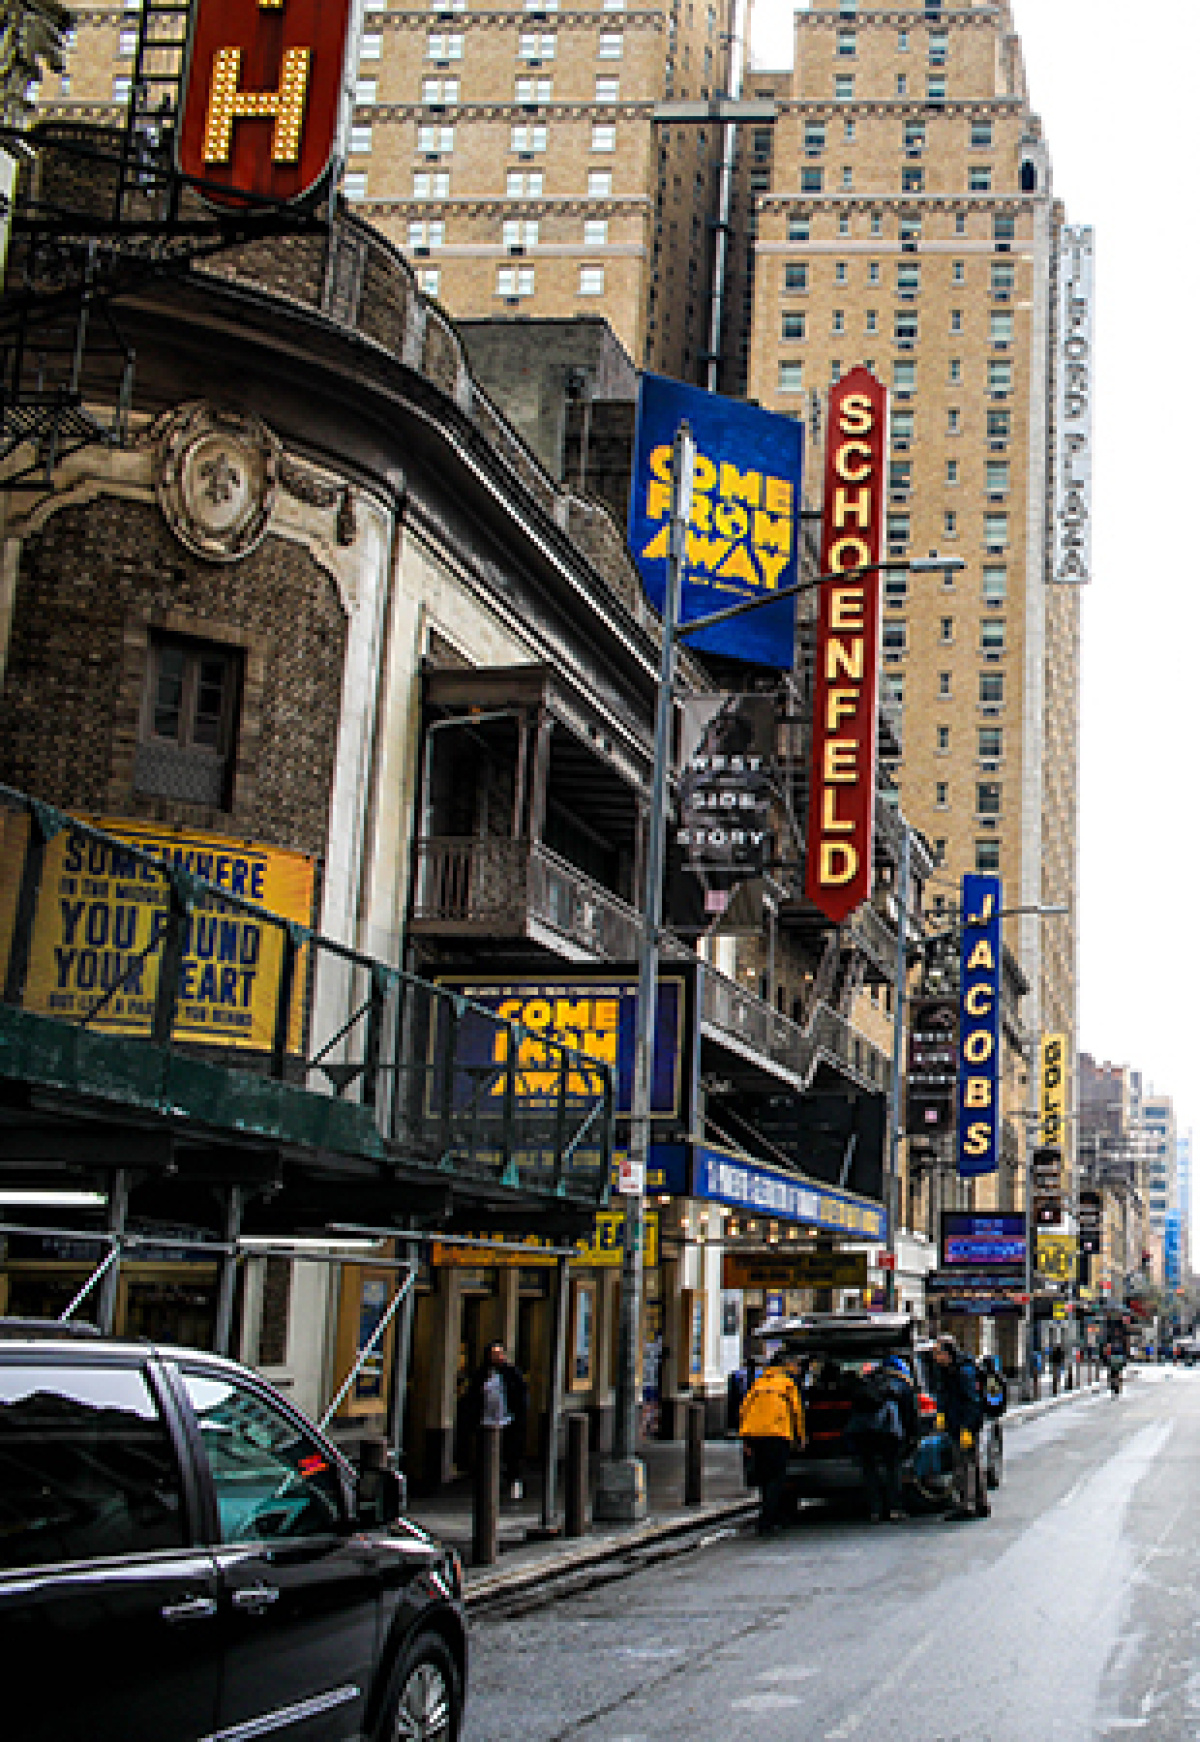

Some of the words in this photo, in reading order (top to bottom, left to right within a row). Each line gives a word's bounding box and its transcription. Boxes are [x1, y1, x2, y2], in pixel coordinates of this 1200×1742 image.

[202, 0, 311, 164] H
[648, 444, 794, 511] COME
[1058, 432, 1089, 579] PLAZA
[819, 395, 874, 886] SCHOENFELD
[56, 948, 144, 996] YOUR
[178, 962, 257, 1008] EART
[60, 900, 138, 950] YOU
[963, 893, 994, 1156] JACOBS
